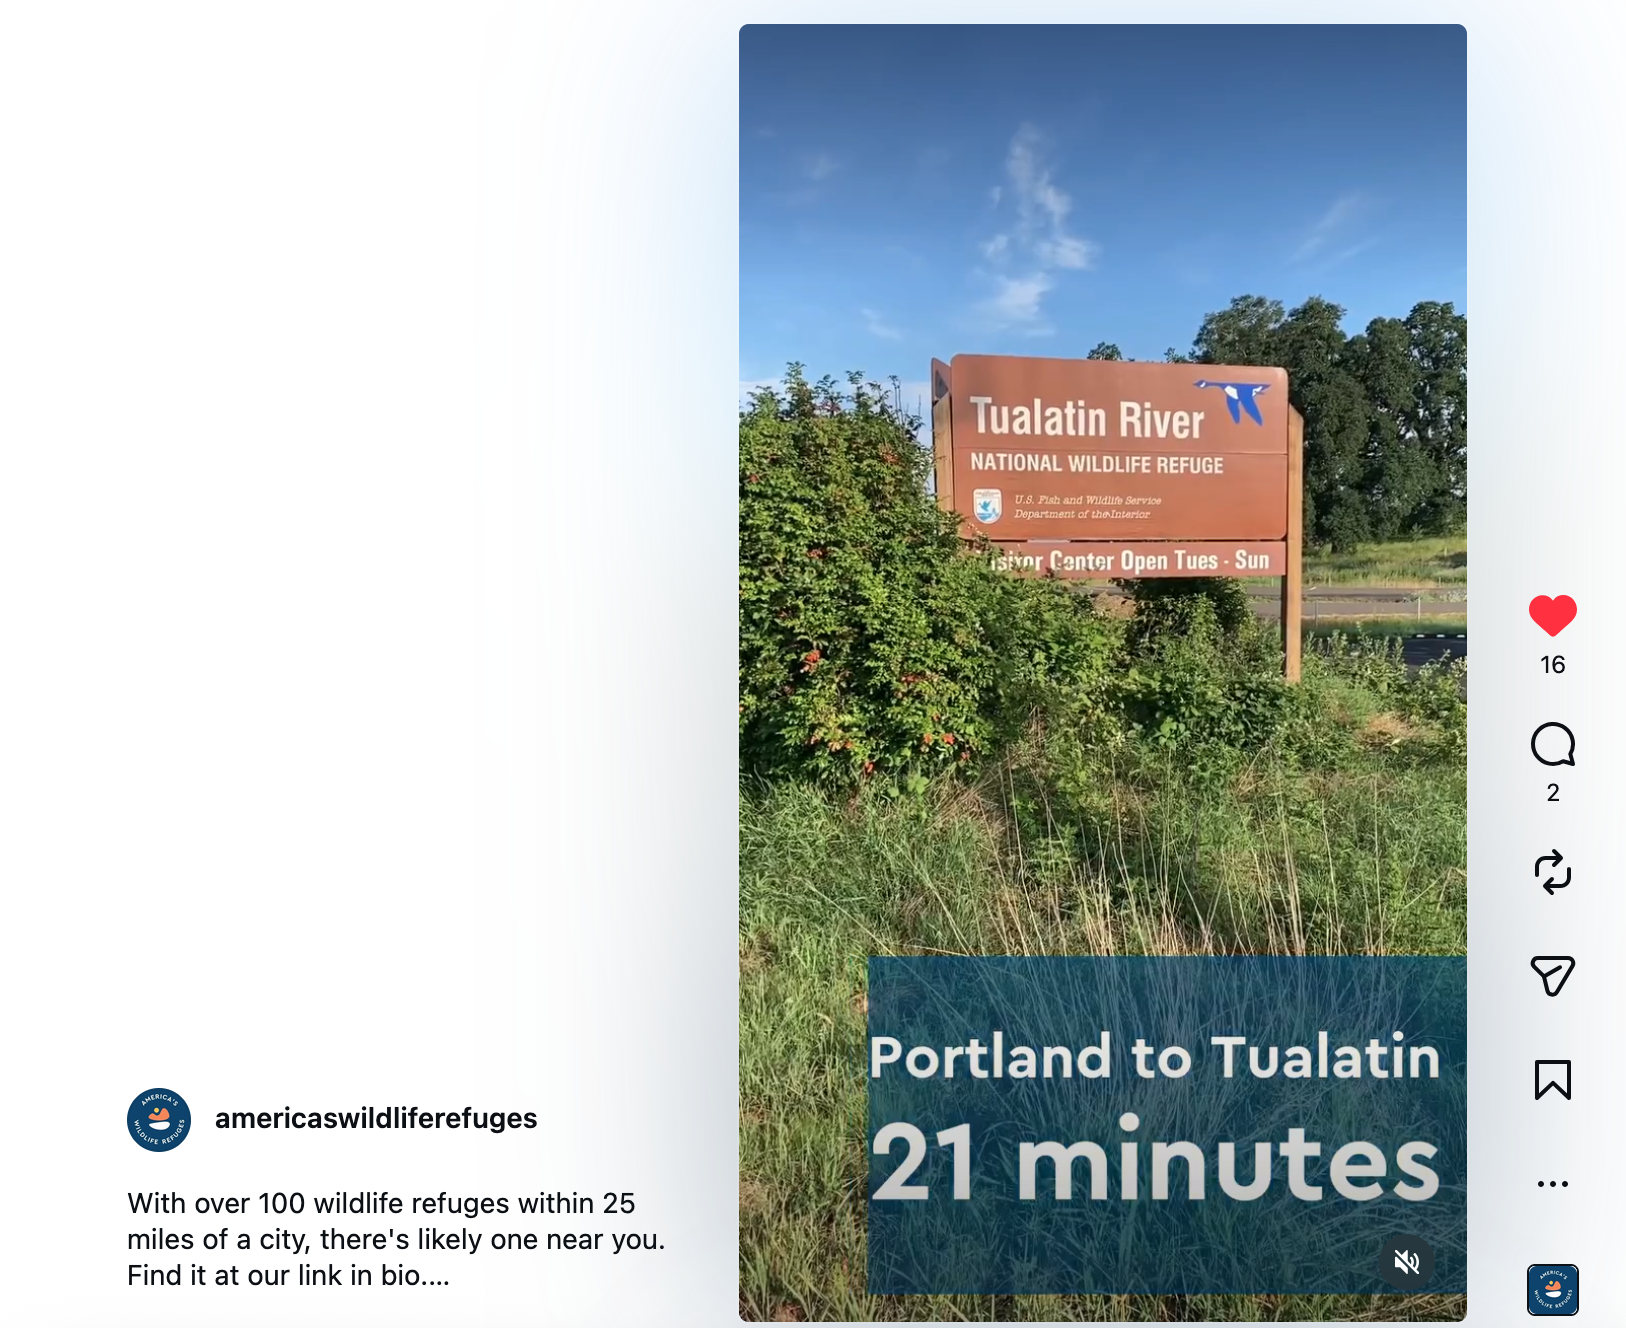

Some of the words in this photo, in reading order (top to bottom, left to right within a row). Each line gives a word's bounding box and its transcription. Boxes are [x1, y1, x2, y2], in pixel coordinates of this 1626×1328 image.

[969, 396, 1106, 437] Tualatin
[1119, 400, 1205, 439] River
[970, 452, 1063, 472] NATIONAL
[1067, 455, 1151, 473] WILDLIFE
[1157, 457, 1224, 474] REFUGE
[1015, 494, 1035, 505] U.S.
[1038, 495, 1061, 505] Fish
[1063, 496, 1083, 505] and
[1086, 495, 1123, 506] Wildlife
[1125, 496, 1162, 506] Service
[1014, 509, 1075, 520] Department
[1078, 510, 1090, 519] of
[1092, 510, 1107, 519] the
[1110, 510, 1151, 519] Interior
[1050, 550, 1114, 571] Center
[1121, 550, 1168, 576] Open
[1174, 550, 1218, 570] Tues
[1235, 550, 1270, 570] Sun
